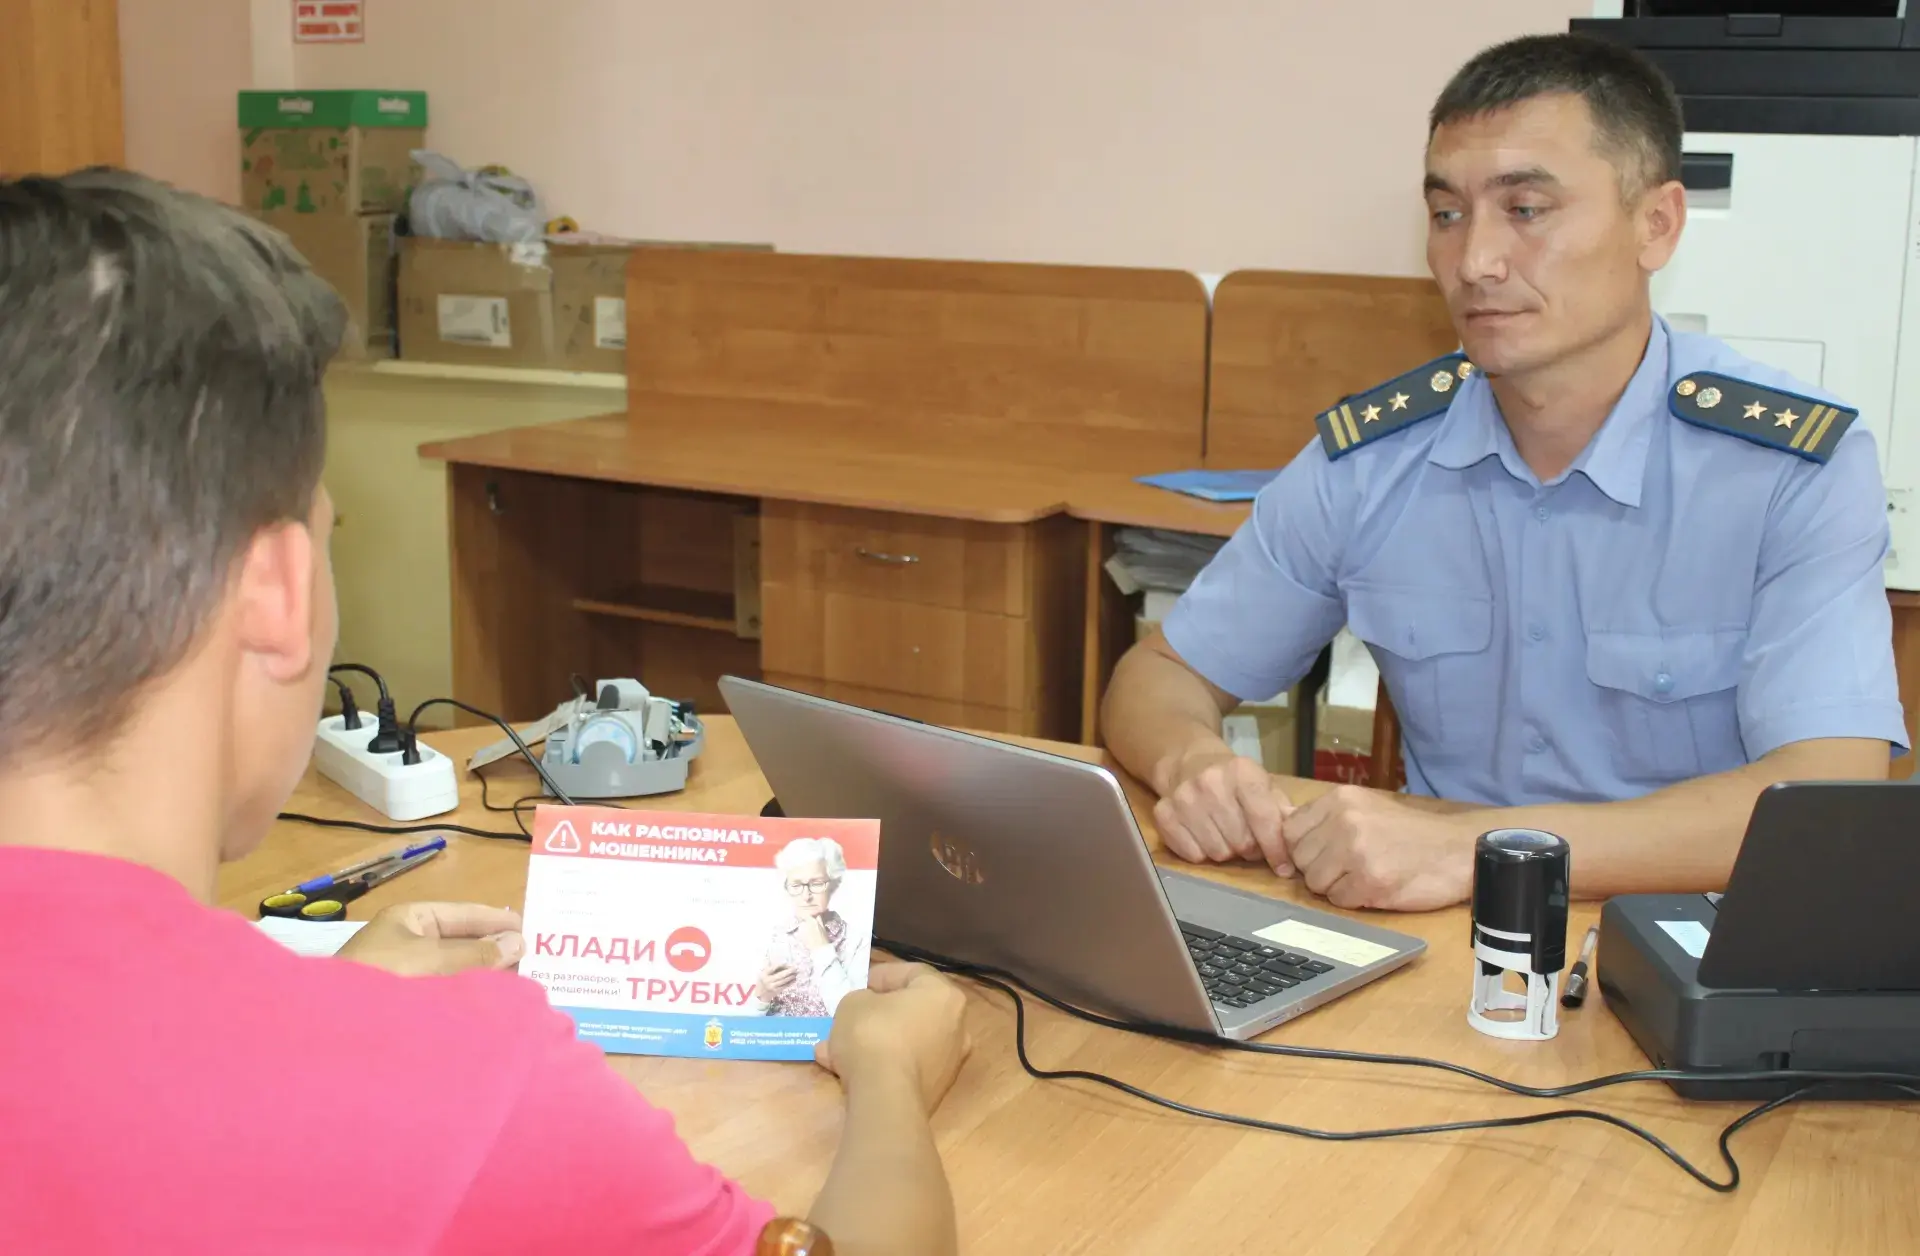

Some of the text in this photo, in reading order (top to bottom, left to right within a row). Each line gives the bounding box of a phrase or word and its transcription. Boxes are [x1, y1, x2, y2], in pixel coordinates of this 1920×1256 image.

[591, 821, 765, 845] КАК РАСПОЗНАТЬ
[589, 841, 728, 863] МОШЕННИКА?
[535, 933, 656, 965] КЛАДИ
[531, 970, 551, 979] Без
[551, 985, 621, 996] мошенники!
[626, 977, 757, 1006] ТРУБКУ
